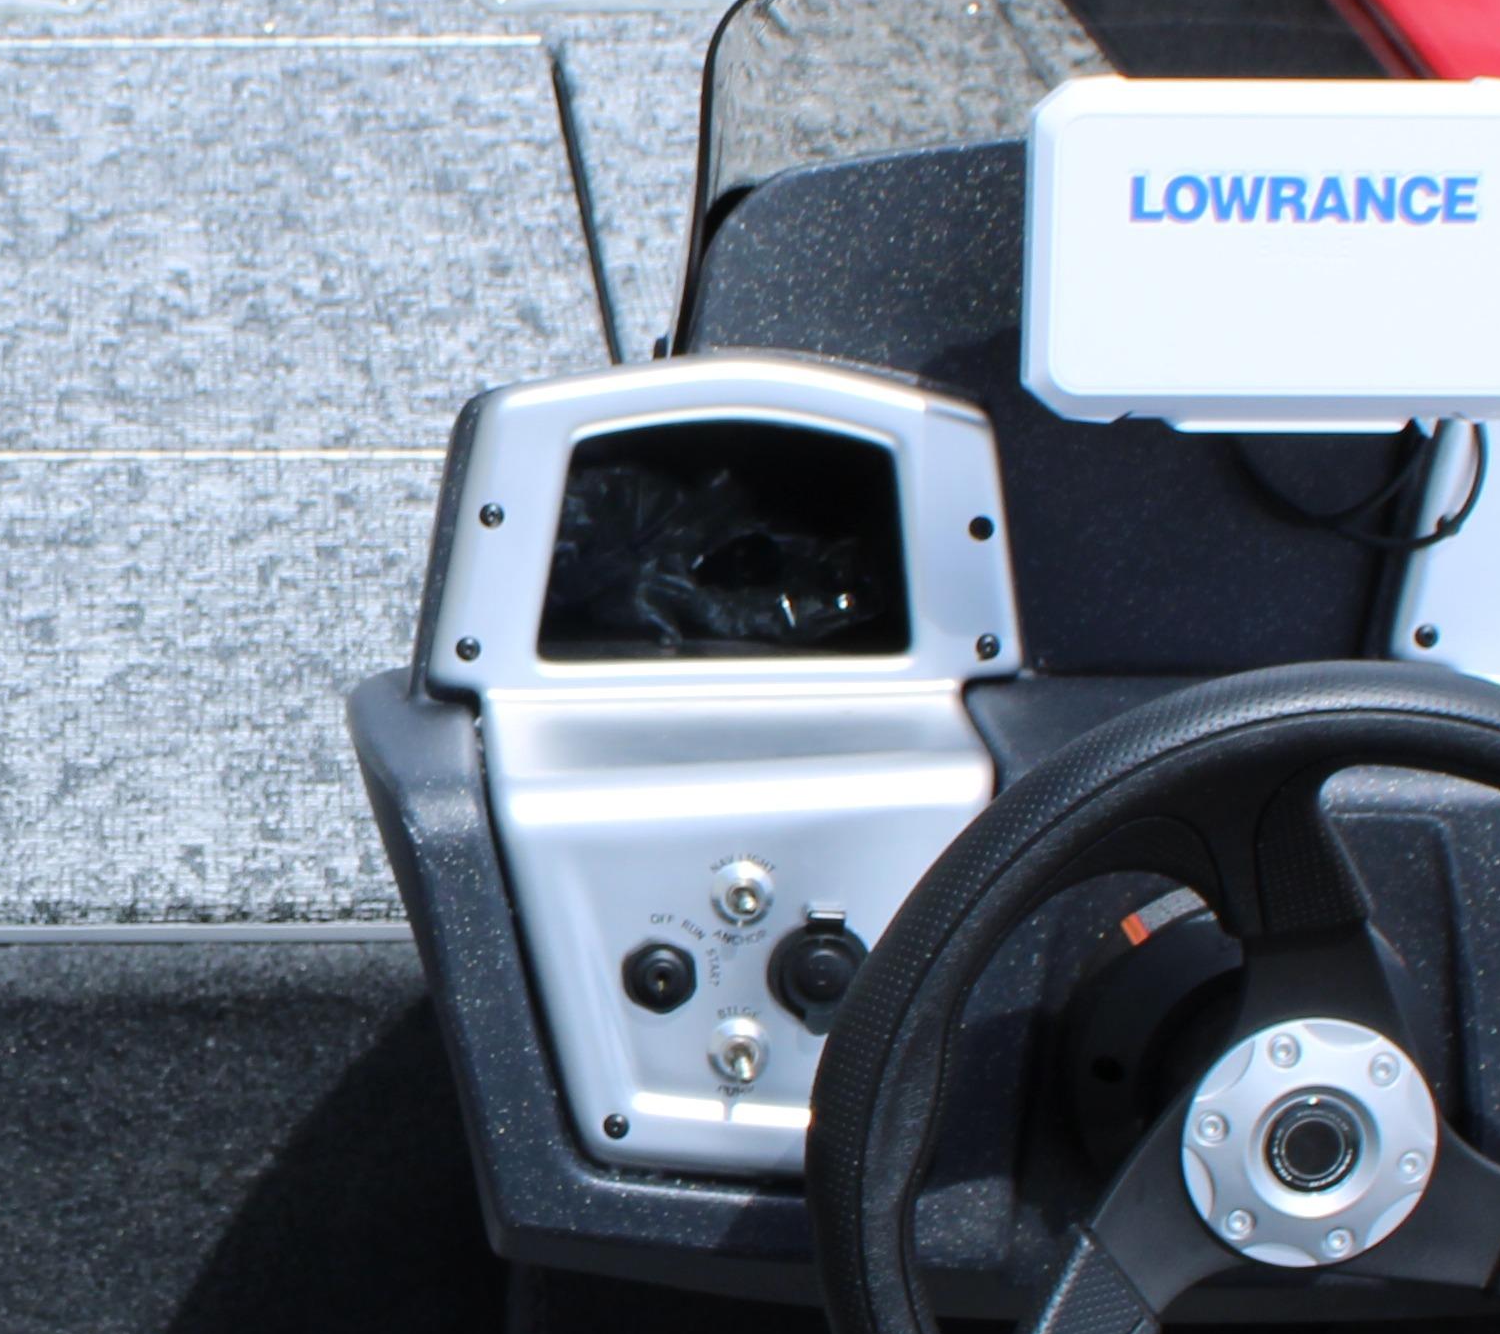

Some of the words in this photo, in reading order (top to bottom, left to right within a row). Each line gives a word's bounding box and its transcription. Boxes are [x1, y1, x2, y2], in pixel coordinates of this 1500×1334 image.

[1129, 175, 1479, 225] LOWRANCE
[650, 913, 675, 925] OFF
[680, 919, 705, 941] RUN
[706, 948, 720, 988] START
[712, 929, 768, 946] ANCHOR
